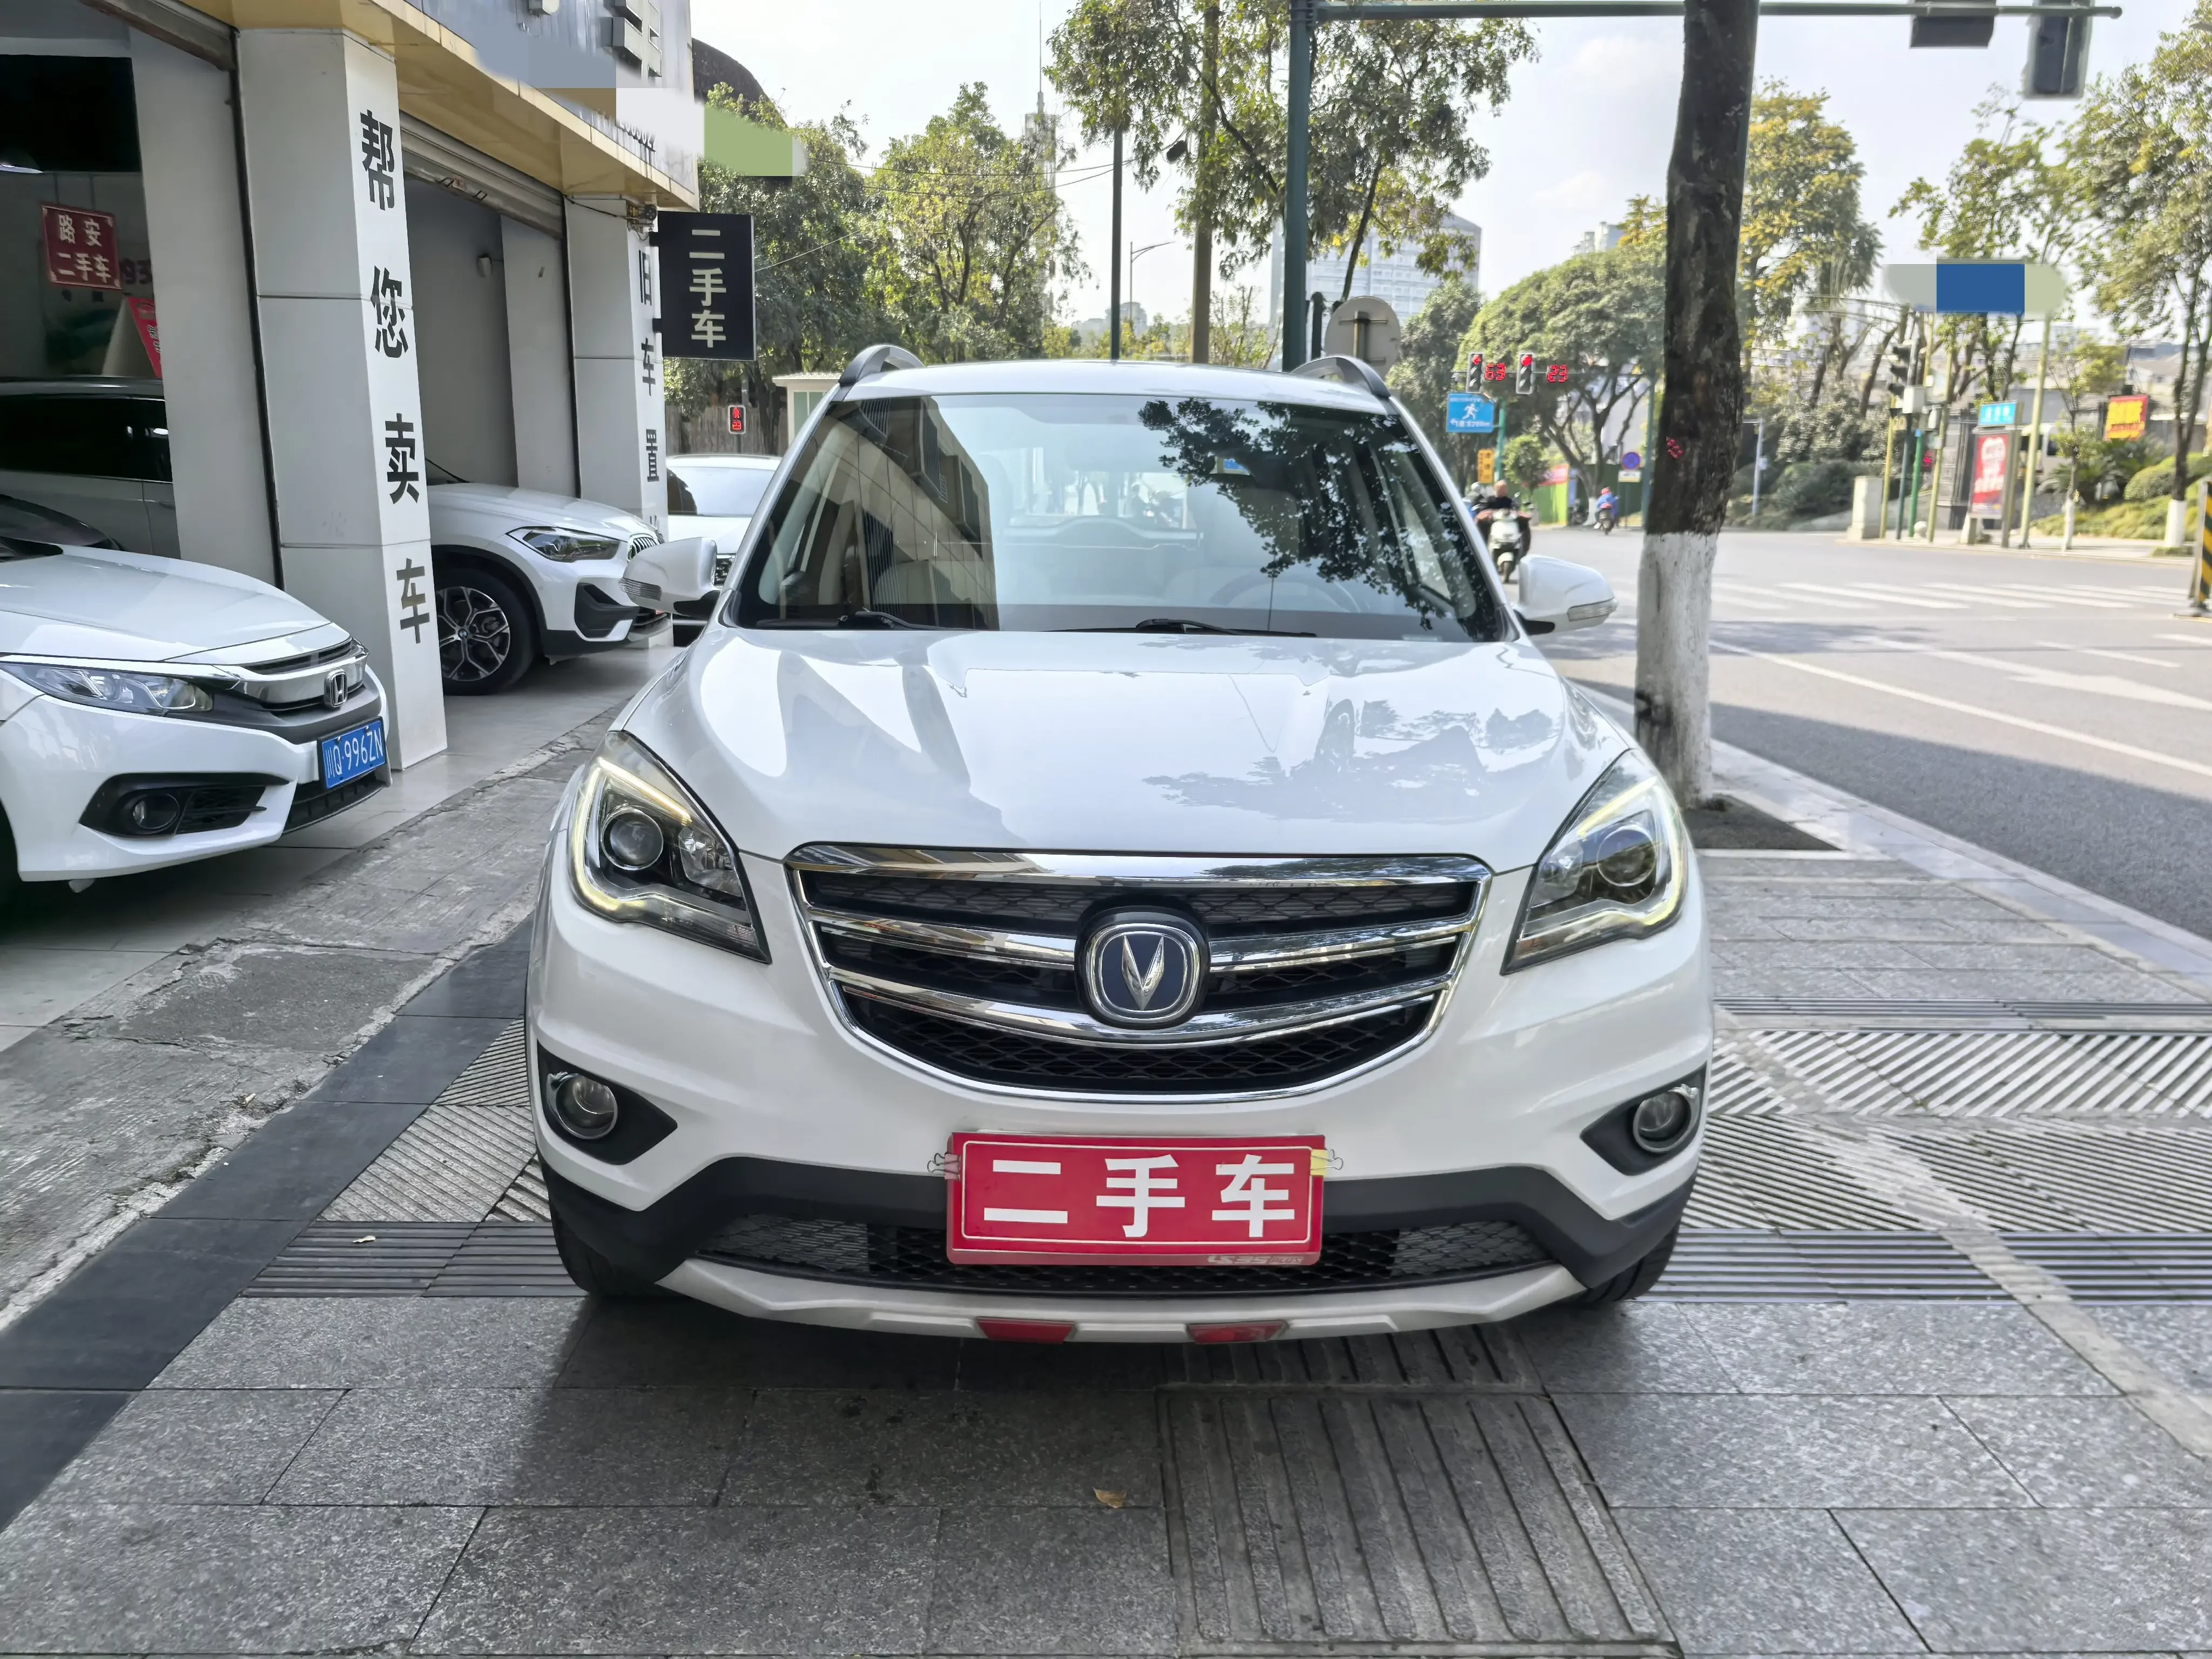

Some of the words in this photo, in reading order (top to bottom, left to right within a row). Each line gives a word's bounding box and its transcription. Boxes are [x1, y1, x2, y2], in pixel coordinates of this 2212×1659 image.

[58, 214, 103, 247] 路安
[57, 252, 111, 284] 二手车
[689, 229, 726, 347] 二手车
[360, 110, 430, 644] 帮您卖车
[638, 250, 660, 525] 旧车置
[1485, 363, 1507, 381] 63
[1547, 365, 1568, 383] 23
[984, 1154, 1294, 1238] 二手车
